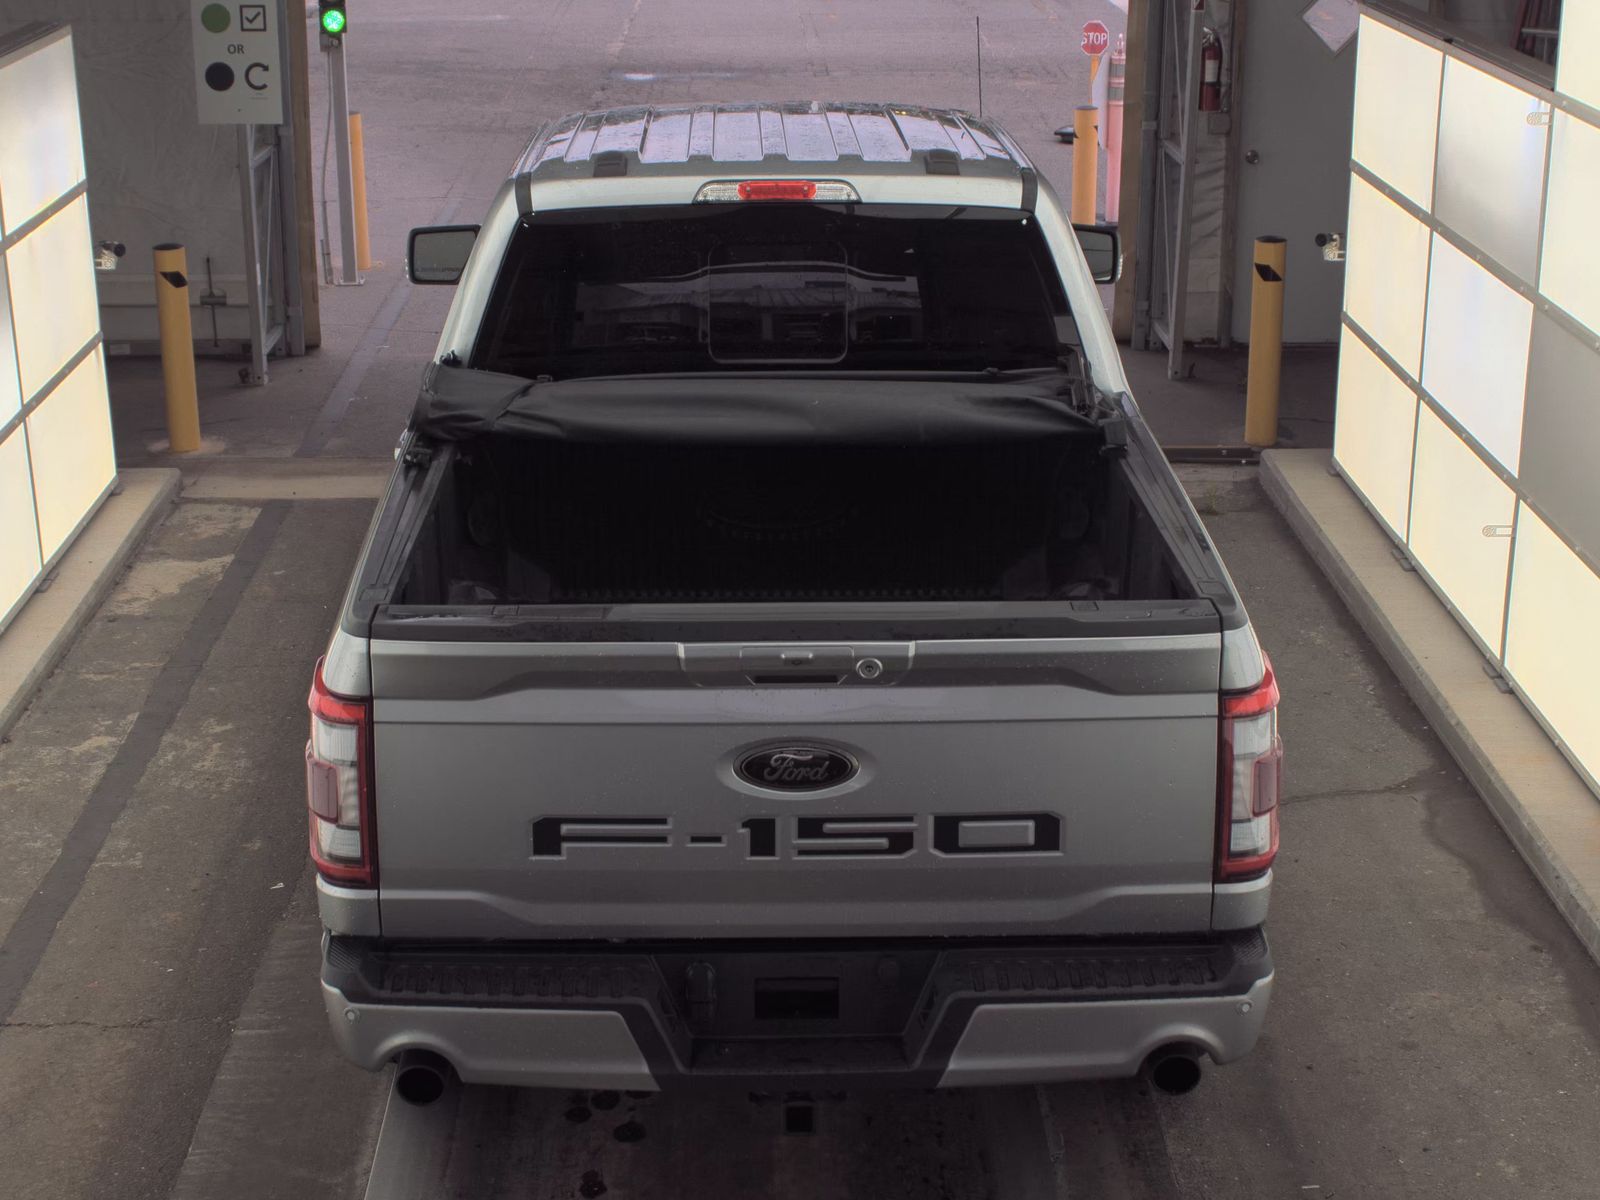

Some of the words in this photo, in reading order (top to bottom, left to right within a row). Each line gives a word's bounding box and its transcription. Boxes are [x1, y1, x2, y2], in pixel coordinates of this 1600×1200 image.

[1081, 32, 1107, 45] STOP
[227, 44, 245, 55] OR
[763, 753, 830, 780] Ford
[529, 813, 1063, 861] F-150
